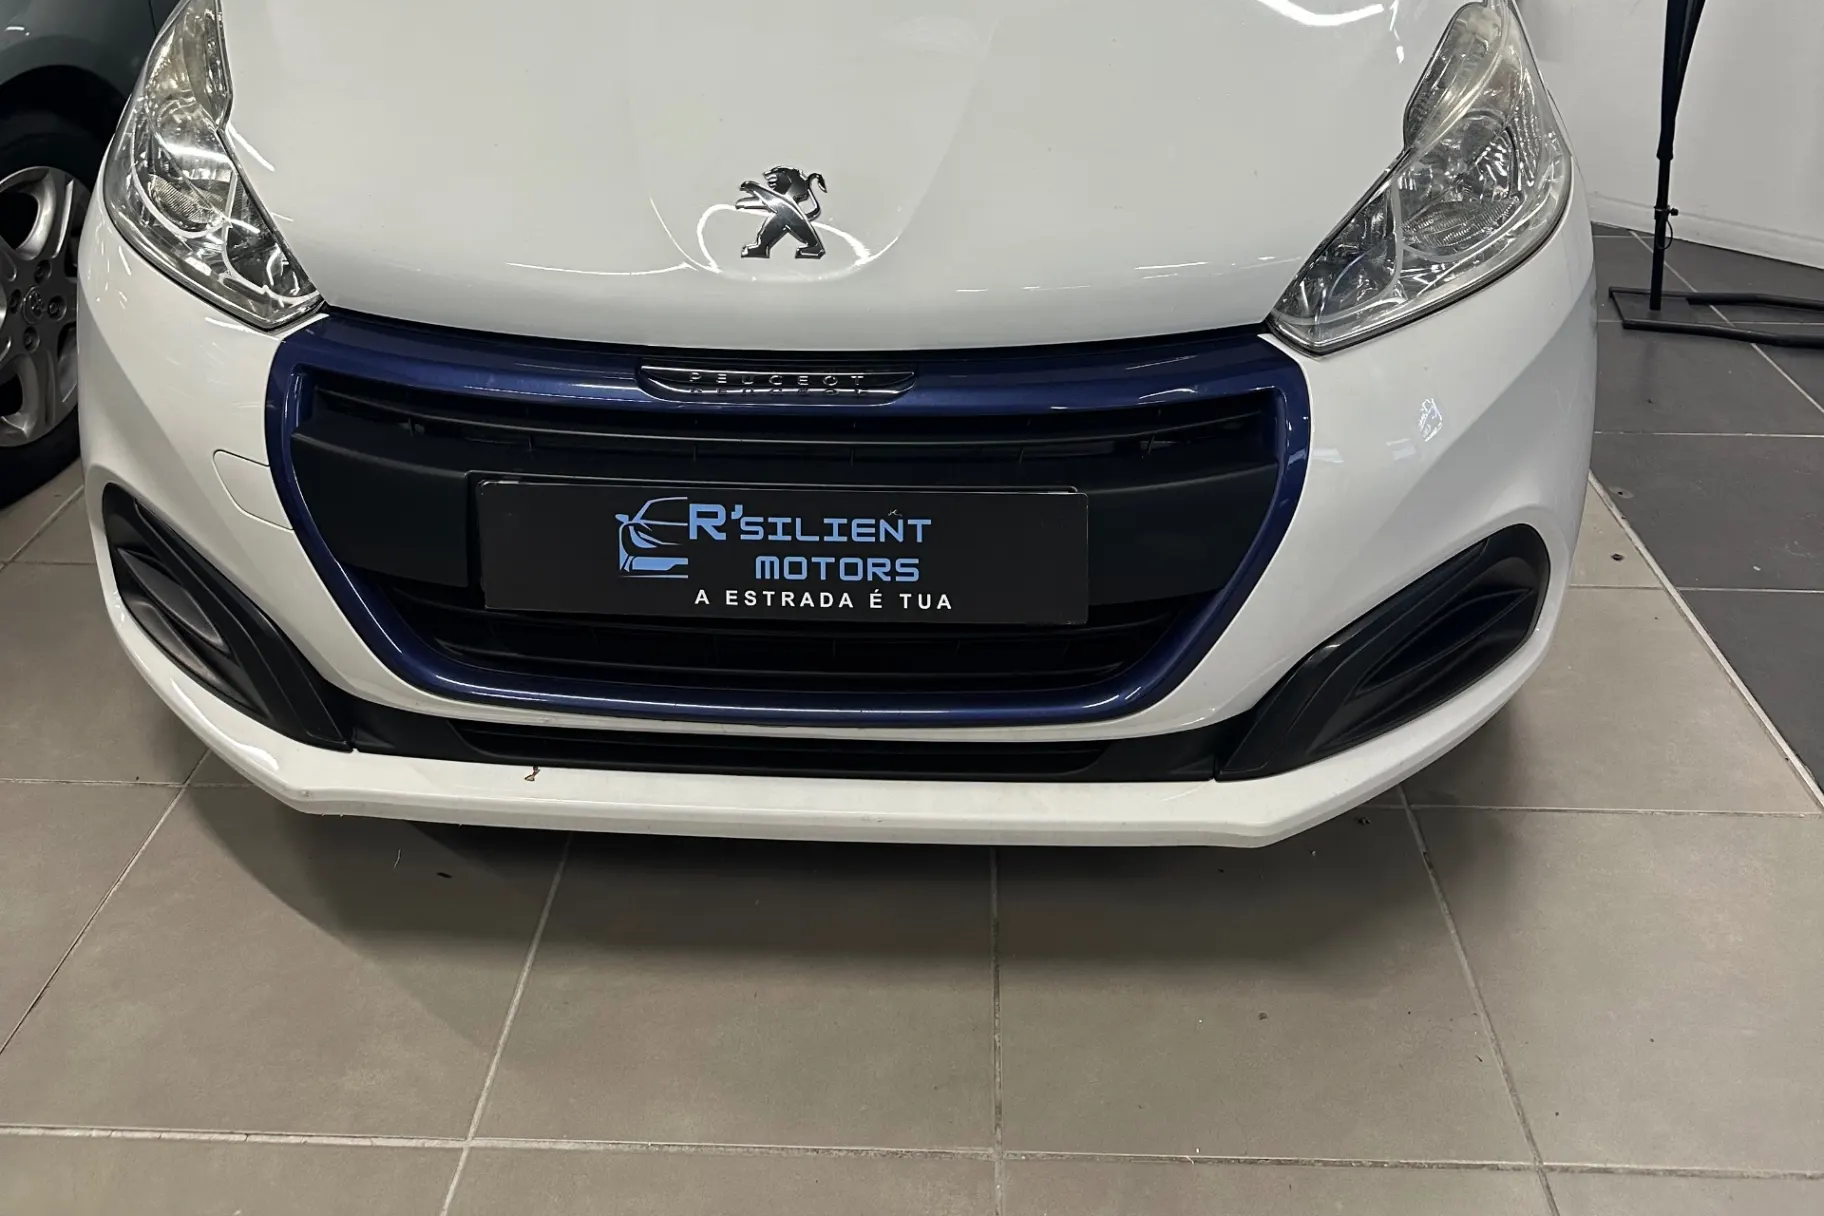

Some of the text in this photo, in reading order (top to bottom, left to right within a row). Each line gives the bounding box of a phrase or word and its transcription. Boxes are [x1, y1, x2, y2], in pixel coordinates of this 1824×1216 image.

[690, 372, 864, 386] PEUGEOT
[690, 504, 931, 542] R'SILIENT
[756, 556, 919, 581] MOTORS
[695, 589, 951, 609] A ESTRADA É TUA
